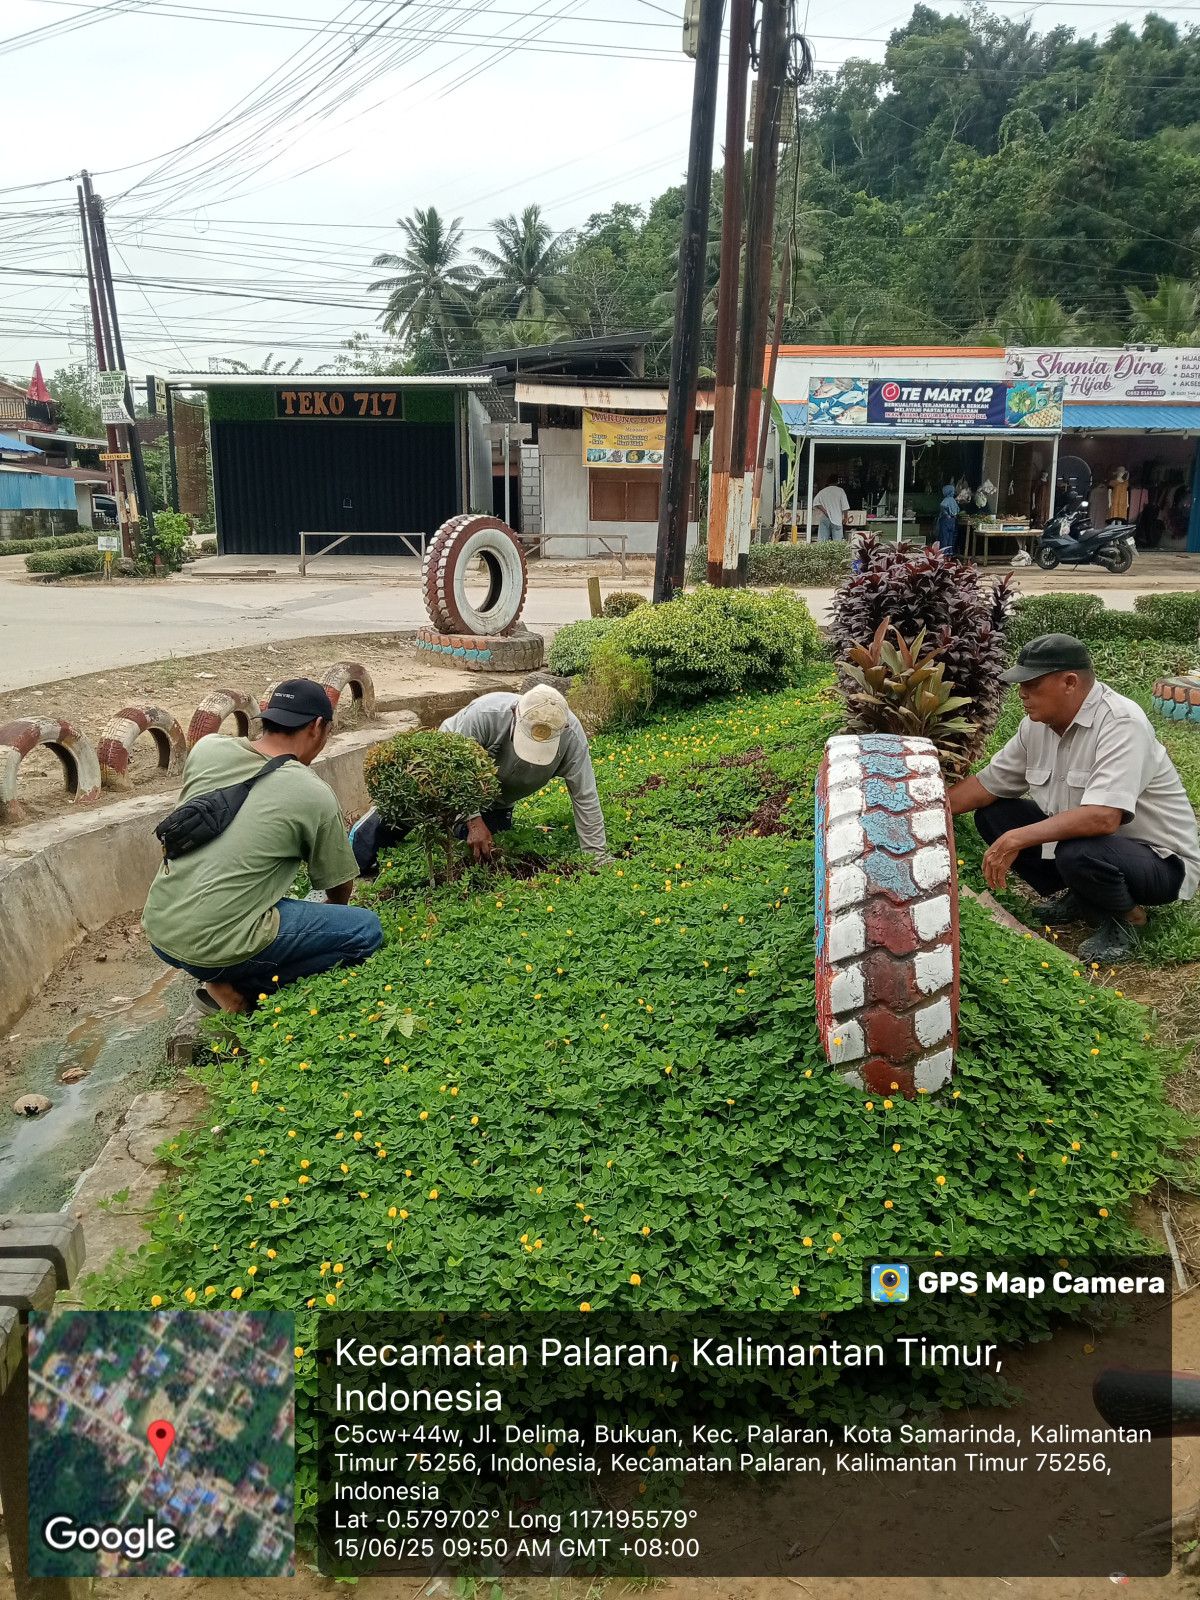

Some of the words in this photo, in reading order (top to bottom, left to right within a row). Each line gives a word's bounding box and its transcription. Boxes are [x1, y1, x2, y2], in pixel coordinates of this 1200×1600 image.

[1032, 352, 1110, 378] Shania
[1114, 354, 1166, 379] Dira
[974, 387, 993, 402] 02
[1070, 376, 1113, 396] Hijab
[281, 392, 345, 415] TEKO
[354, 392, 396, 416] 717
